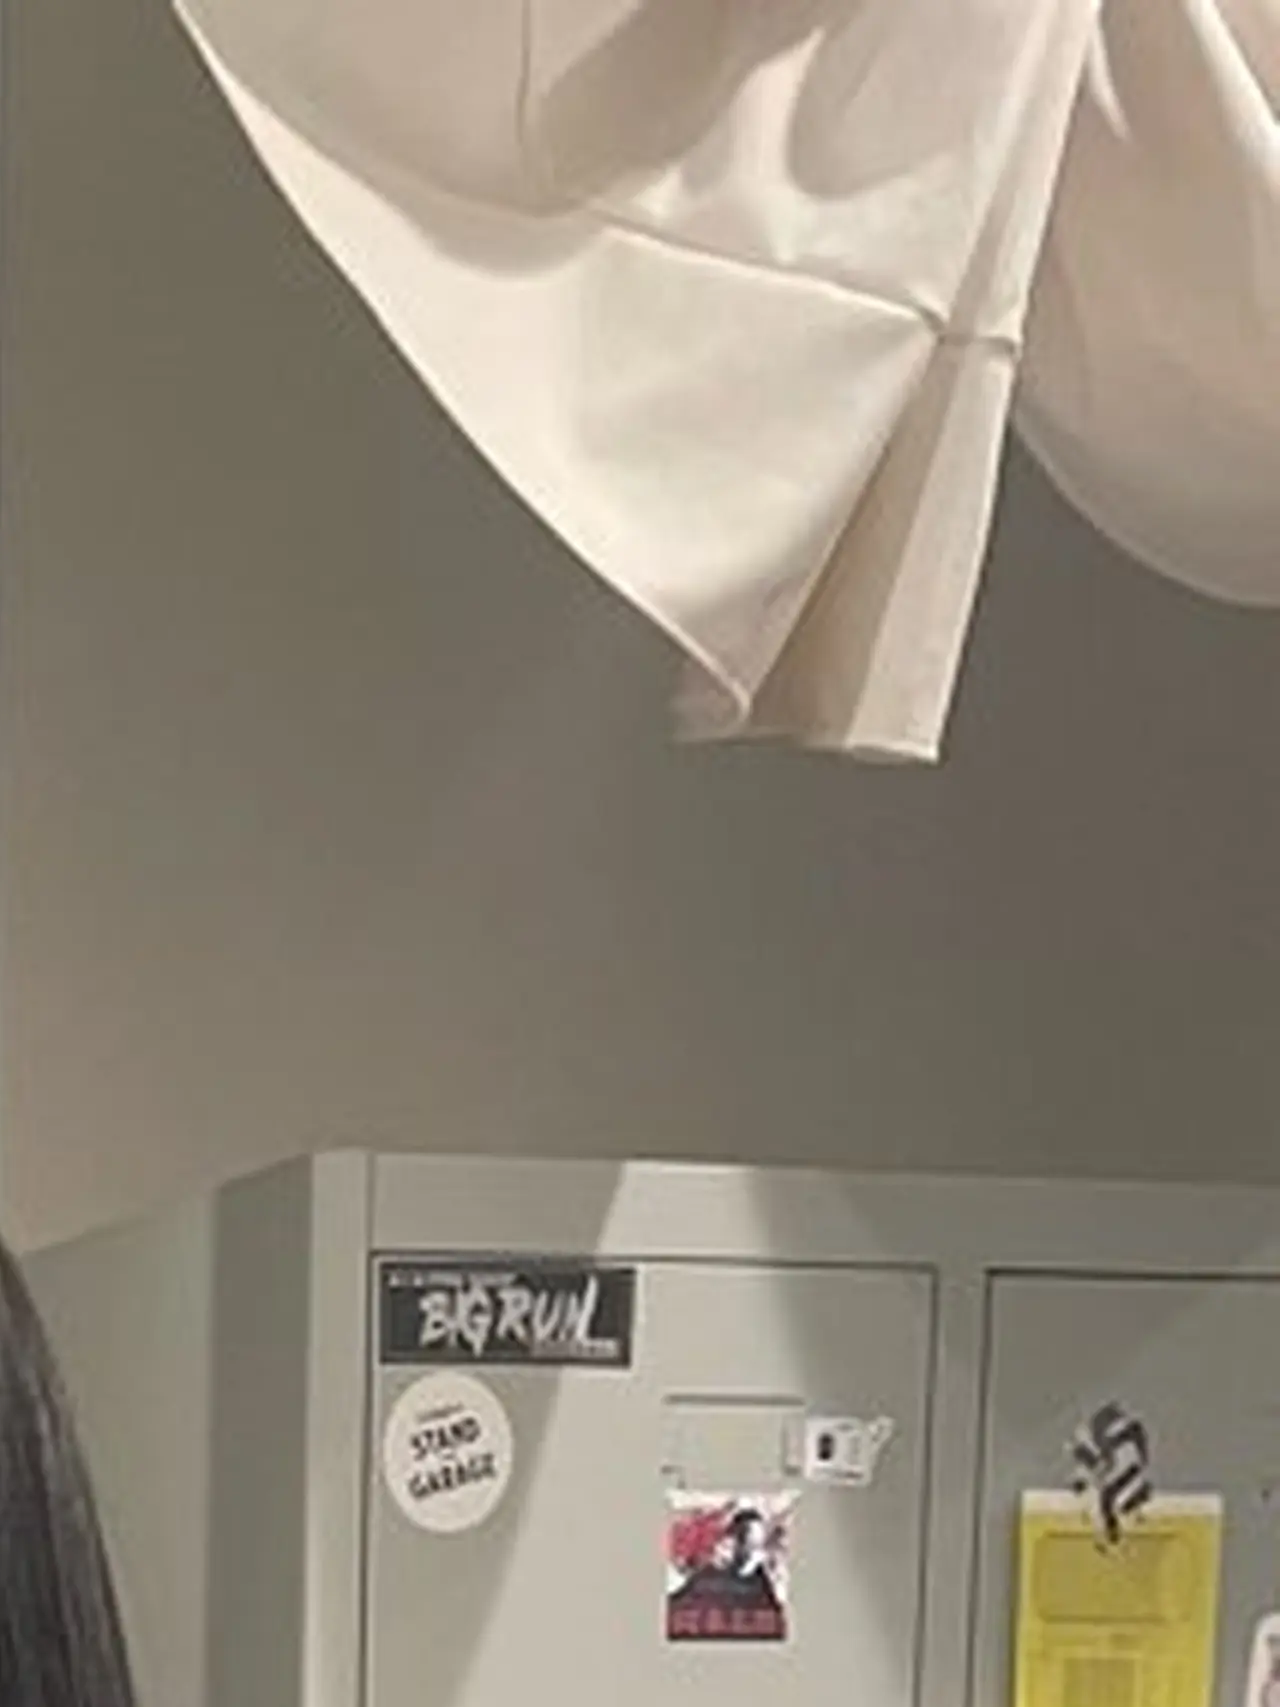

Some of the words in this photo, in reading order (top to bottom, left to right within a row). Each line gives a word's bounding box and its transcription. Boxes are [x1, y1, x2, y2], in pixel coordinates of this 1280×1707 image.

[418, 1283, 492, 1357] BIG
[494, 1275, 618, 1354] RUN
[411, 1416, 482, 1461] STAND
[407, 1453, 496, 1501] GARAGE
